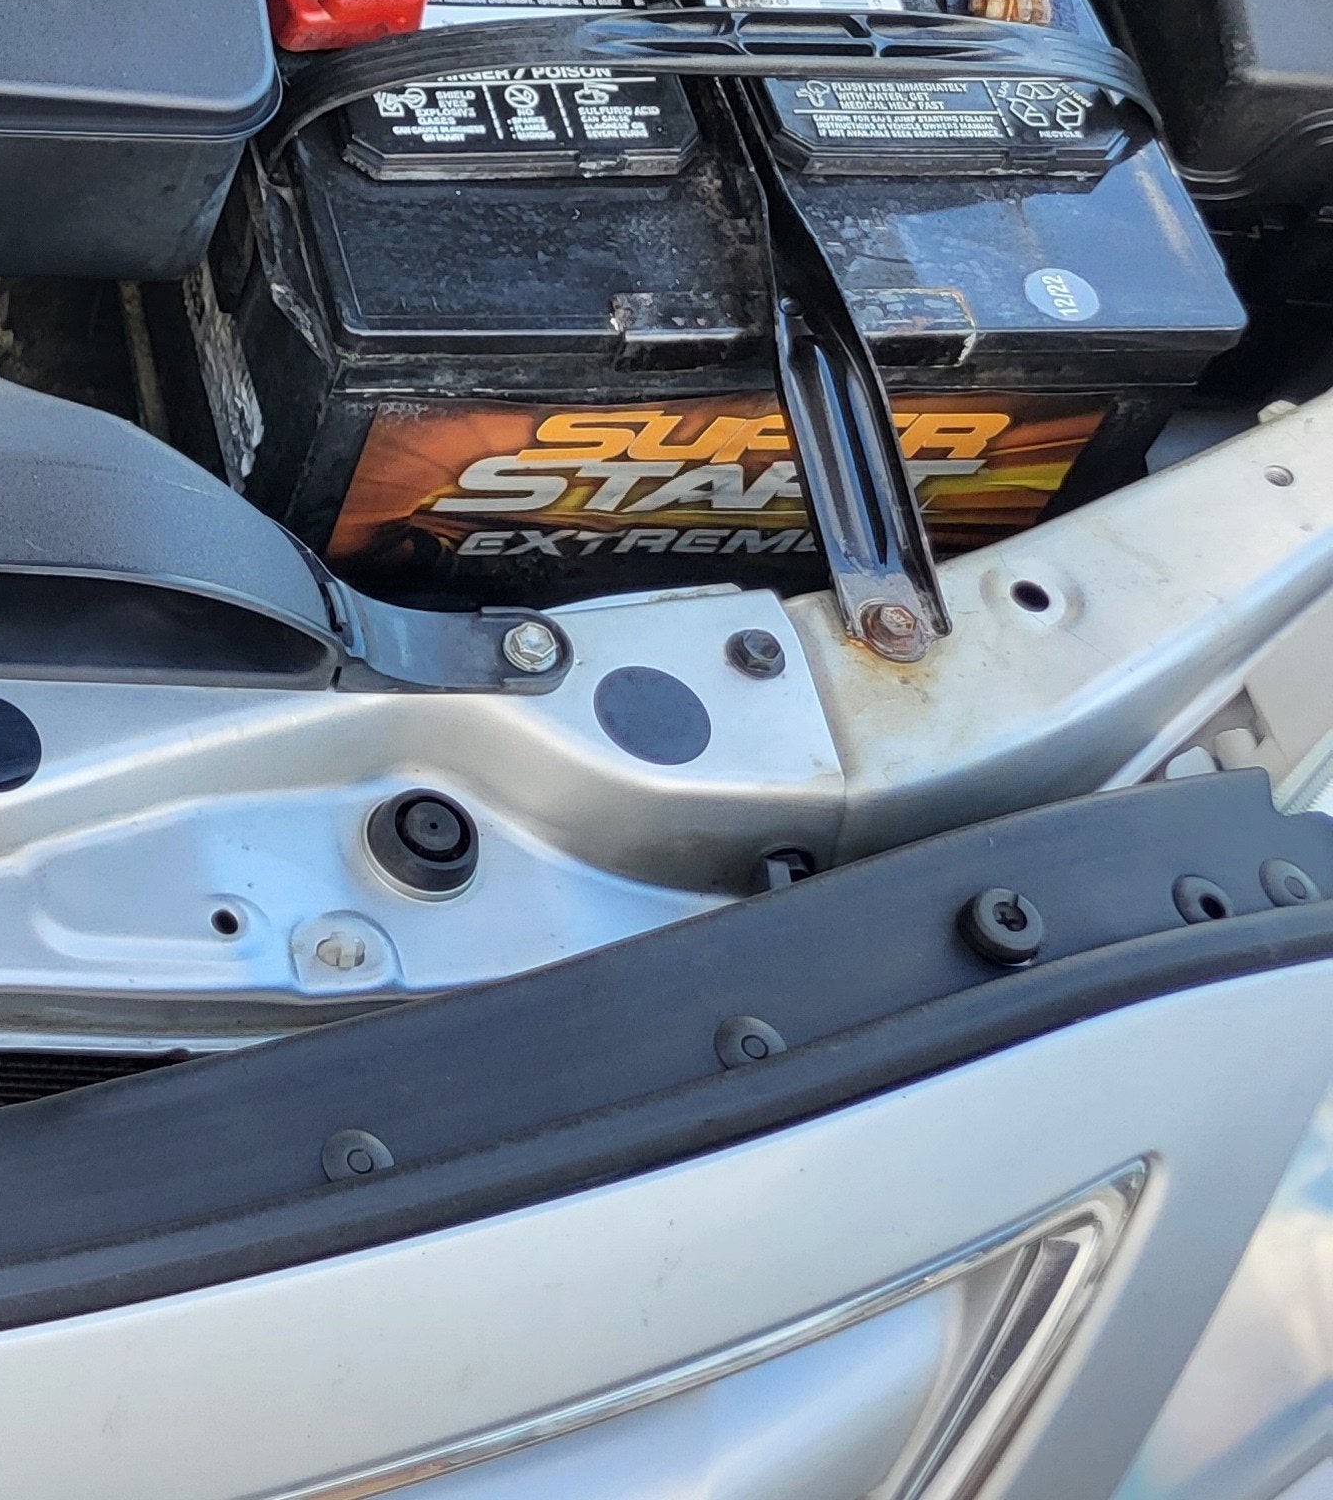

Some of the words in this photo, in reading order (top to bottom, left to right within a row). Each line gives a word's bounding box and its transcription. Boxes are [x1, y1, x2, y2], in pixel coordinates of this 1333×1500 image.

[531, 66, 612, 79] POISON
[831, 82, 868, 92] FLUSH
[868, 82, 893, 92] EYES
[895, 82, 967, 93] IMMEDIATELY
[434, 89, 476, 100] SHIELD
[836, 92, 864, 101] WITH
[909, 92, 930, 101] GET
[437, 99, 468, 108] EYES
[840, 101, 888, 110] MEDICAL
[889, 101, 917, 110] HELP
[918, 102, 944, 110] FAST
[414, 107, 477, 118] EXPLOSIVE
[517, 108, 535, 117] NO
[578, 105, 633, 116] SULFURIC
[633, 105, 660, 116] ACID
[1041, 274, 1080, 316] 12/22
[517, 411, 1011, 463] SUPR
[457, 528, 819, 557] EXTREM
